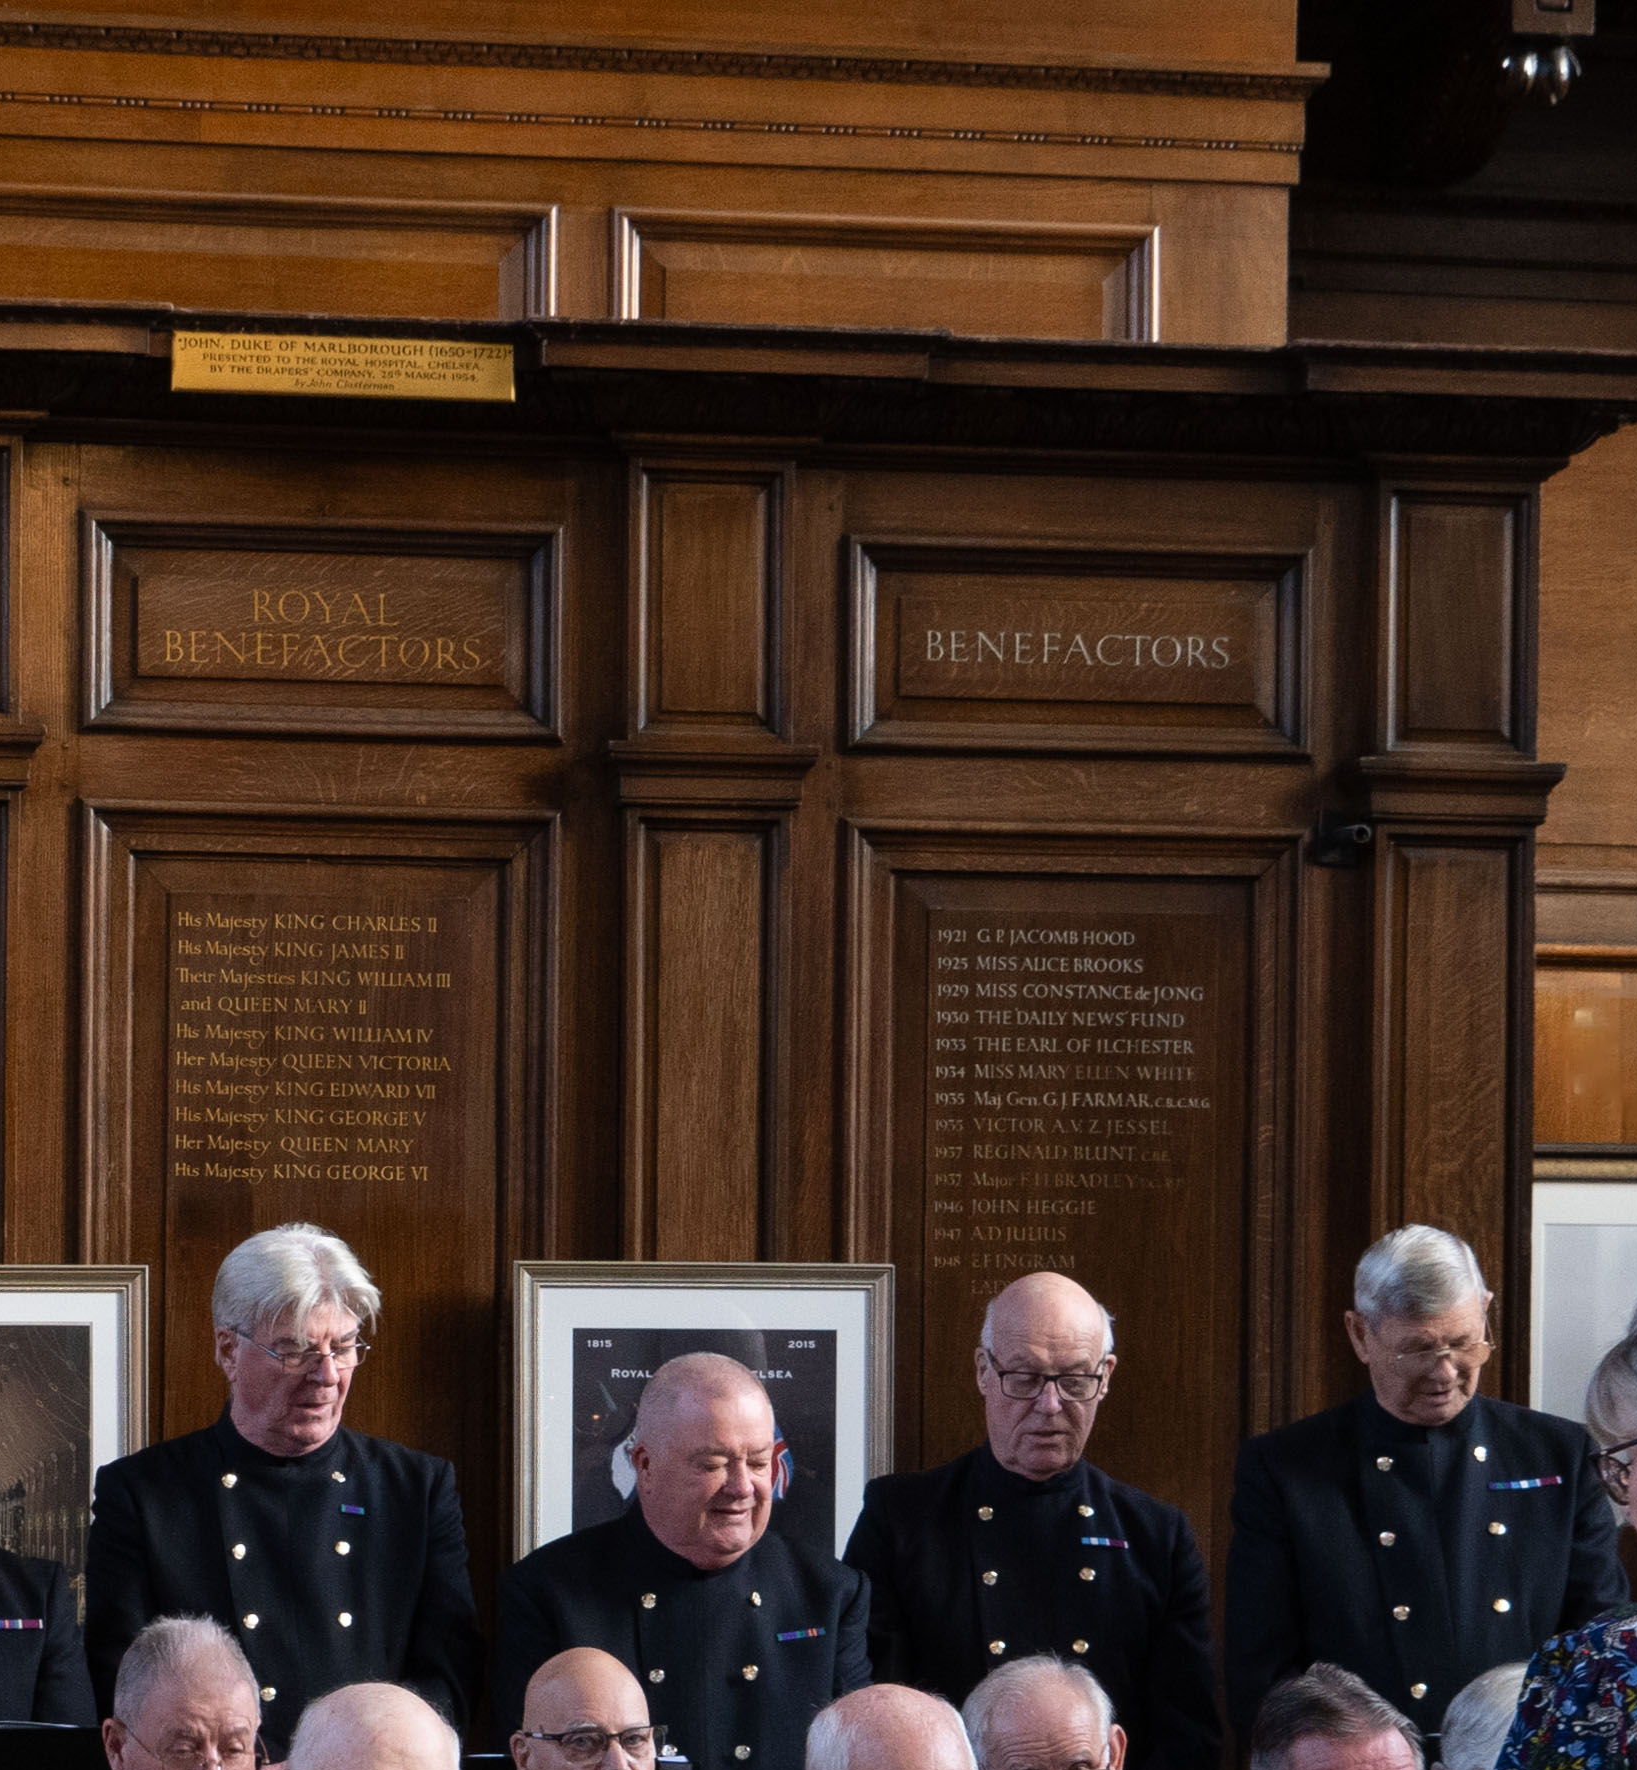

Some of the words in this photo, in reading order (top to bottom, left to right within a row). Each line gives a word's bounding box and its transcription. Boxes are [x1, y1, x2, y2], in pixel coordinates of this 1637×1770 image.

[230, 339, 273, 351] DUKE
[278, 340, 297, 352] OF
[303, 341, 424, 358] MARLBOROUGH
[252, 588, 399, 627] ROYAL
[164, 629, 481, 670] BENEFACTORS
[927, 630, 1229, 669] BENEFACTORS
[178, 912, 201, 927] His
[207, 913, 267, 937] Majesty
[275, 914, 324, 929] KING
[332, 916, 420, 931] CHARLES
[428, 918, 437, 932] II
[938, 930, 966, 944] 1921
[1011, 930, 1078, 945] JACOMB
[1084, 932, 1135, 946] HOOD
[178, 940, 201, 954] His
[206, 941, 266, 965] Majesty
[275, 943, 323, 958] KING
[331, 944, 389, 963] JAMES
[395, 945, 403, 959] II
[938, 957, 968, 971] 1925
[976, 956, 1017, 971] MISS
[1023, 958, 1068, 972] ALICE
[1074, 958, 1143, 973] BROOKS
[176, 968, 214, 982] Their
[220, 969, 295, 991] Majesties
[301, 971, 350, 985] KING
[357, 972, 431, 987] WILLIAM
[437, 974, 450, 987] III
[181, 996, 210, 1010] and
[218, 997, 287, 1015] QUEEN
[295, 998, 352, 1013] MARY
[359, 1000, 366, 1014] II
[938, 985, 968, 997] 1929
[976, 984, 1016, 998] MISS
[1023, 984, 1132, 999] CONSTANCE
[1135, 987, 1151, 999] de
[1154, 986, 1203, 1004] JONG
[937, 1011, 969, 1024] 1930
[976, 1010, 1011, 1025] THE
[1132, 1013, 1184, 1027] FUND
[176, 1023, 199, 1038] His
[205, 1024, 266, 1049] Majesty
[275, 1026, 324, 1041] KING
[333, 1027, 411, 1042] WILLIAM
[417, 1029, 433, 1043] IV
[936, 1039, 966, 1050] 1933
[974, 1037, 1010, 1052] THE
[1017, 1038, 1057, 1052] EARL
[1067, 1039, 1091, 1052] OF
[1098, 1039, 1195, 1055] ILCHESTER
[176, 1051, 204, 1066] Her
[210, 1052, 276, 1076] Majesty
[283, 1054, 351, 1073] QUEEN
[359, 1056, 451, 1071] VICTORIA
[176, 1079, 200, 1093] His
[206, 1080, 269, 1102] Majesty
[275, 1082, 323, 1096] KING
[331, 1083, 409, 1098] EDWARD
[416, 1085, 435, 1098] VII
[936, 1093, 964, 1106] 1935
[175, 1107, 201, 1122] His
[206, 1108, 267, 1132] Majesty
[275, 1109, 324, 1124] KING
[330, 1111, 408, 1126] GEORGE
[413, 1112, 426, 1126] V
[175, 1135, 203, 1149] Her
[208, 1135, 271, 1159] Majesty
[280, 1137, 348, 1156] QUEEN
[356, 1138, 413, 1153] MARY
[175, 1163, 199, 1176] His
[205, 1163, 266, 1184] Majesty
[274, 1165, 320, 1179] KING
[327, 1166, 404, 1180] GEORGE
[412, 1166, 428, 1181] VI
[611, 1368, 653, 1379] ROYAL
